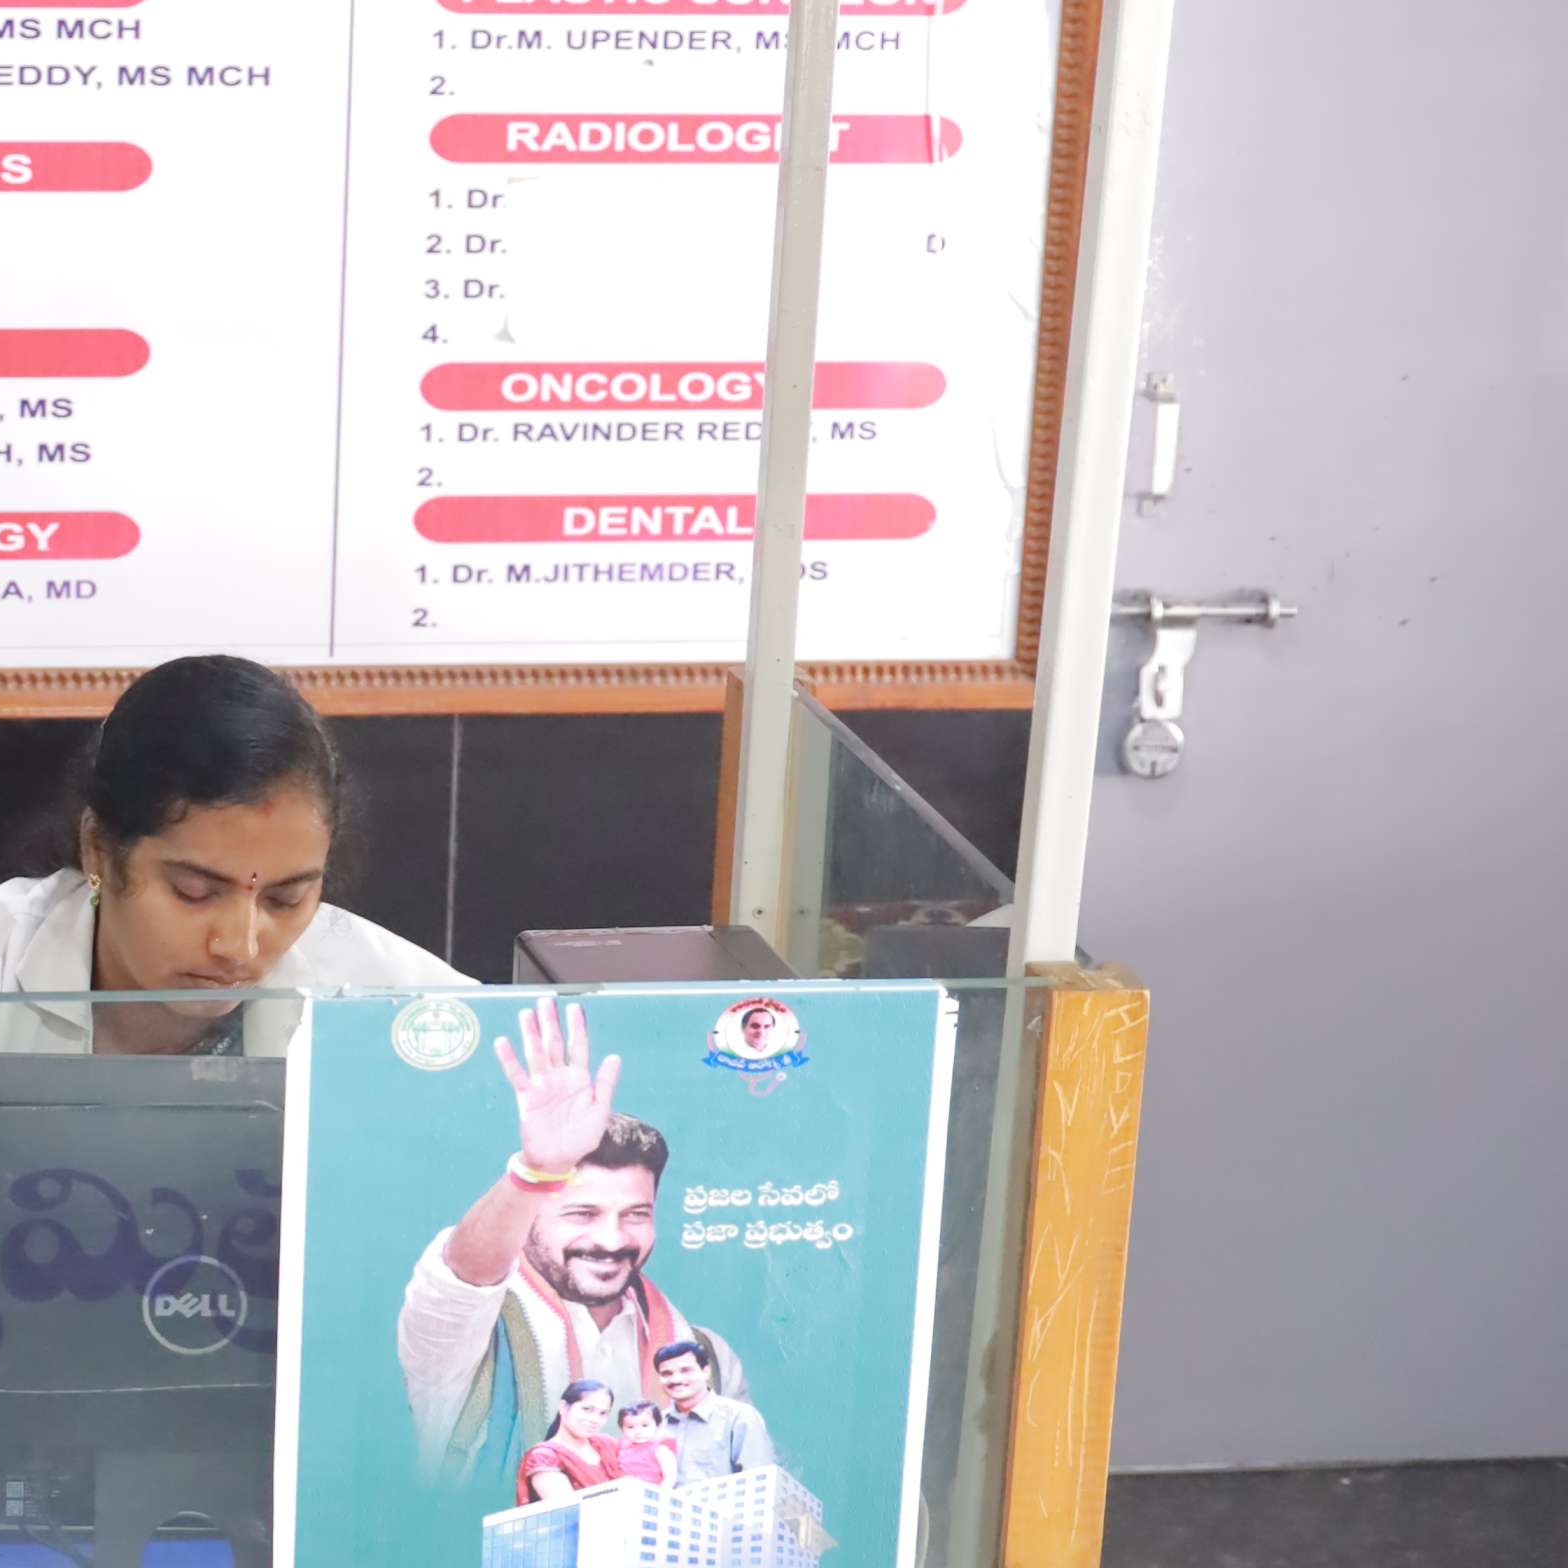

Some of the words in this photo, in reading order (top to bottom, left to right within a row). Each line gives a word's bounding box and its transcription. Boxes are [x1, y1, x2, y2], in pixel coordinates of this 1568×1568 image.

[57, 19, 140, 39] MCH
[433, 30, 456, 49] 1.
[471, 30, 550, 49] Dr.M.
[567, 30, 740, 51] UPENDER,
[118, 66, 171, 86] MS
[187, 66, 270, 86] MCH
[430, 76, 454, 95] 2.
[506, 122, 850, 153] RADIOLOGIT
[430, 189, 452, 208] 1.
[426, 234, 450, 254] 2.
[466, 234, 505, 253] Dr.
[425, 279, 449, 299] 3.
[464, 279, 504, 298] Dr.
[422, 324, 447, 343] 4.
[20, 399, 72, 418] MS
[421, 424, 443, 442] 1.
[458, 423, 497, 442] Dr.
[513, 422, 683, 441] RAVINDER
[697, 422, 817, 443] RED,
[831, 421, 876, 440] MS
[38, 443, 91, 462] MS
[417, 467, 442, 486] 2.
[563, 506, 754, 536] DENTAL
[416, 565, 438, 583] 1.
[453, 564, 492, 583] Dr.
[47, 580, 96, 599] MD
[412, 608, 436, 627] 2.
[683, 1185, 752, 1214] ప్రజల
[758, 1180, 839, 1206] సేవలో
[682, 1221, 739, 1249] ప్రజా
[744, 1220, 854, 1249] ప్రభుత్వం
[155, 1293, 235, 1318] DELL
